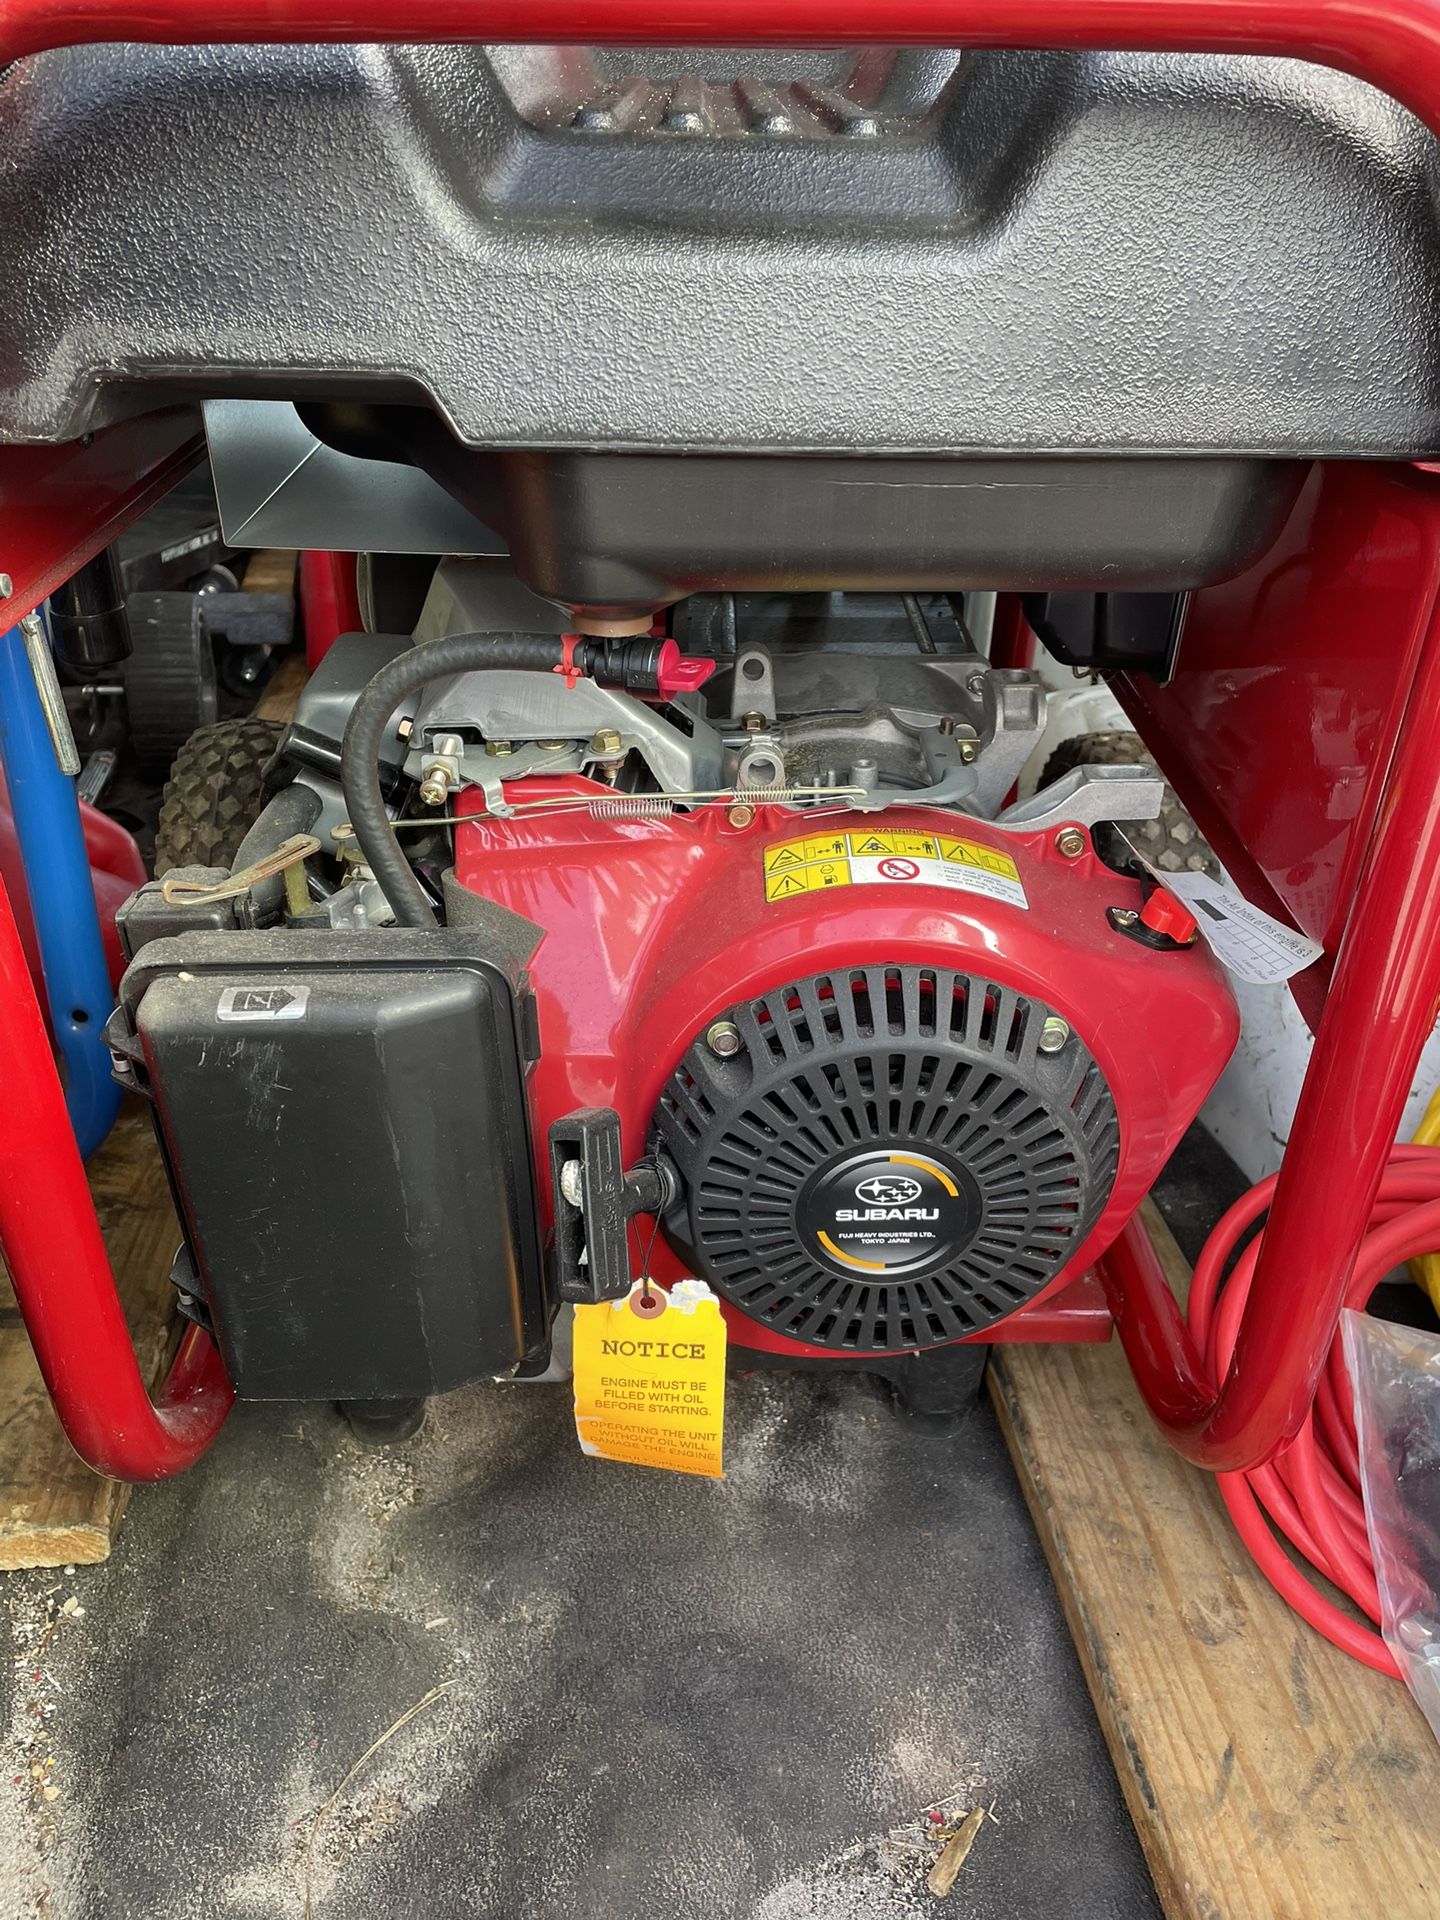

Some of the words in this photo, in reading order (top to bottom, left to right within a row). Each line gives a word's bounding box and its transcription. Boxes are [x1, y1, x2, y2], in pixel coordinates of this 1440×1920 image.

[1261, 923, 1277, 935] this
[1273, 932, 1300, 950] engine
[835, 1208, 940, 1222] SUBARU
[601, 1339, 706, 1360] NOTICE
[601, 1377, 648, 1389] ENGINE
[651, 1380, 687, 1391] MUST
[690, 1382, 707, 1392] BE
[603, 1389, 645, 1400] FILLED
[648, 1392, 680, 1402] WITH
[683, 1394, 704, 1404] OIL
[595, 1399, 645, 1412] BEFORE
[648, 1404, 712, 1416] STARTING.
[590, 1420, 659, 1436] OPERATING
[662, 1428, 686, 1439] THE
[689, 1431, 718, 1442] UNIT
[599, 1430, 655, 1444] WITHOUT
[658, 1438, 677, 1447] OIL
[680, 1440, 708, 1451] WILL
[590, 1435, 641, 1449] DAMAGE
[642, 1443, 667, 1453] THE
[669, 1448, 719, 1461] ENGINE.
